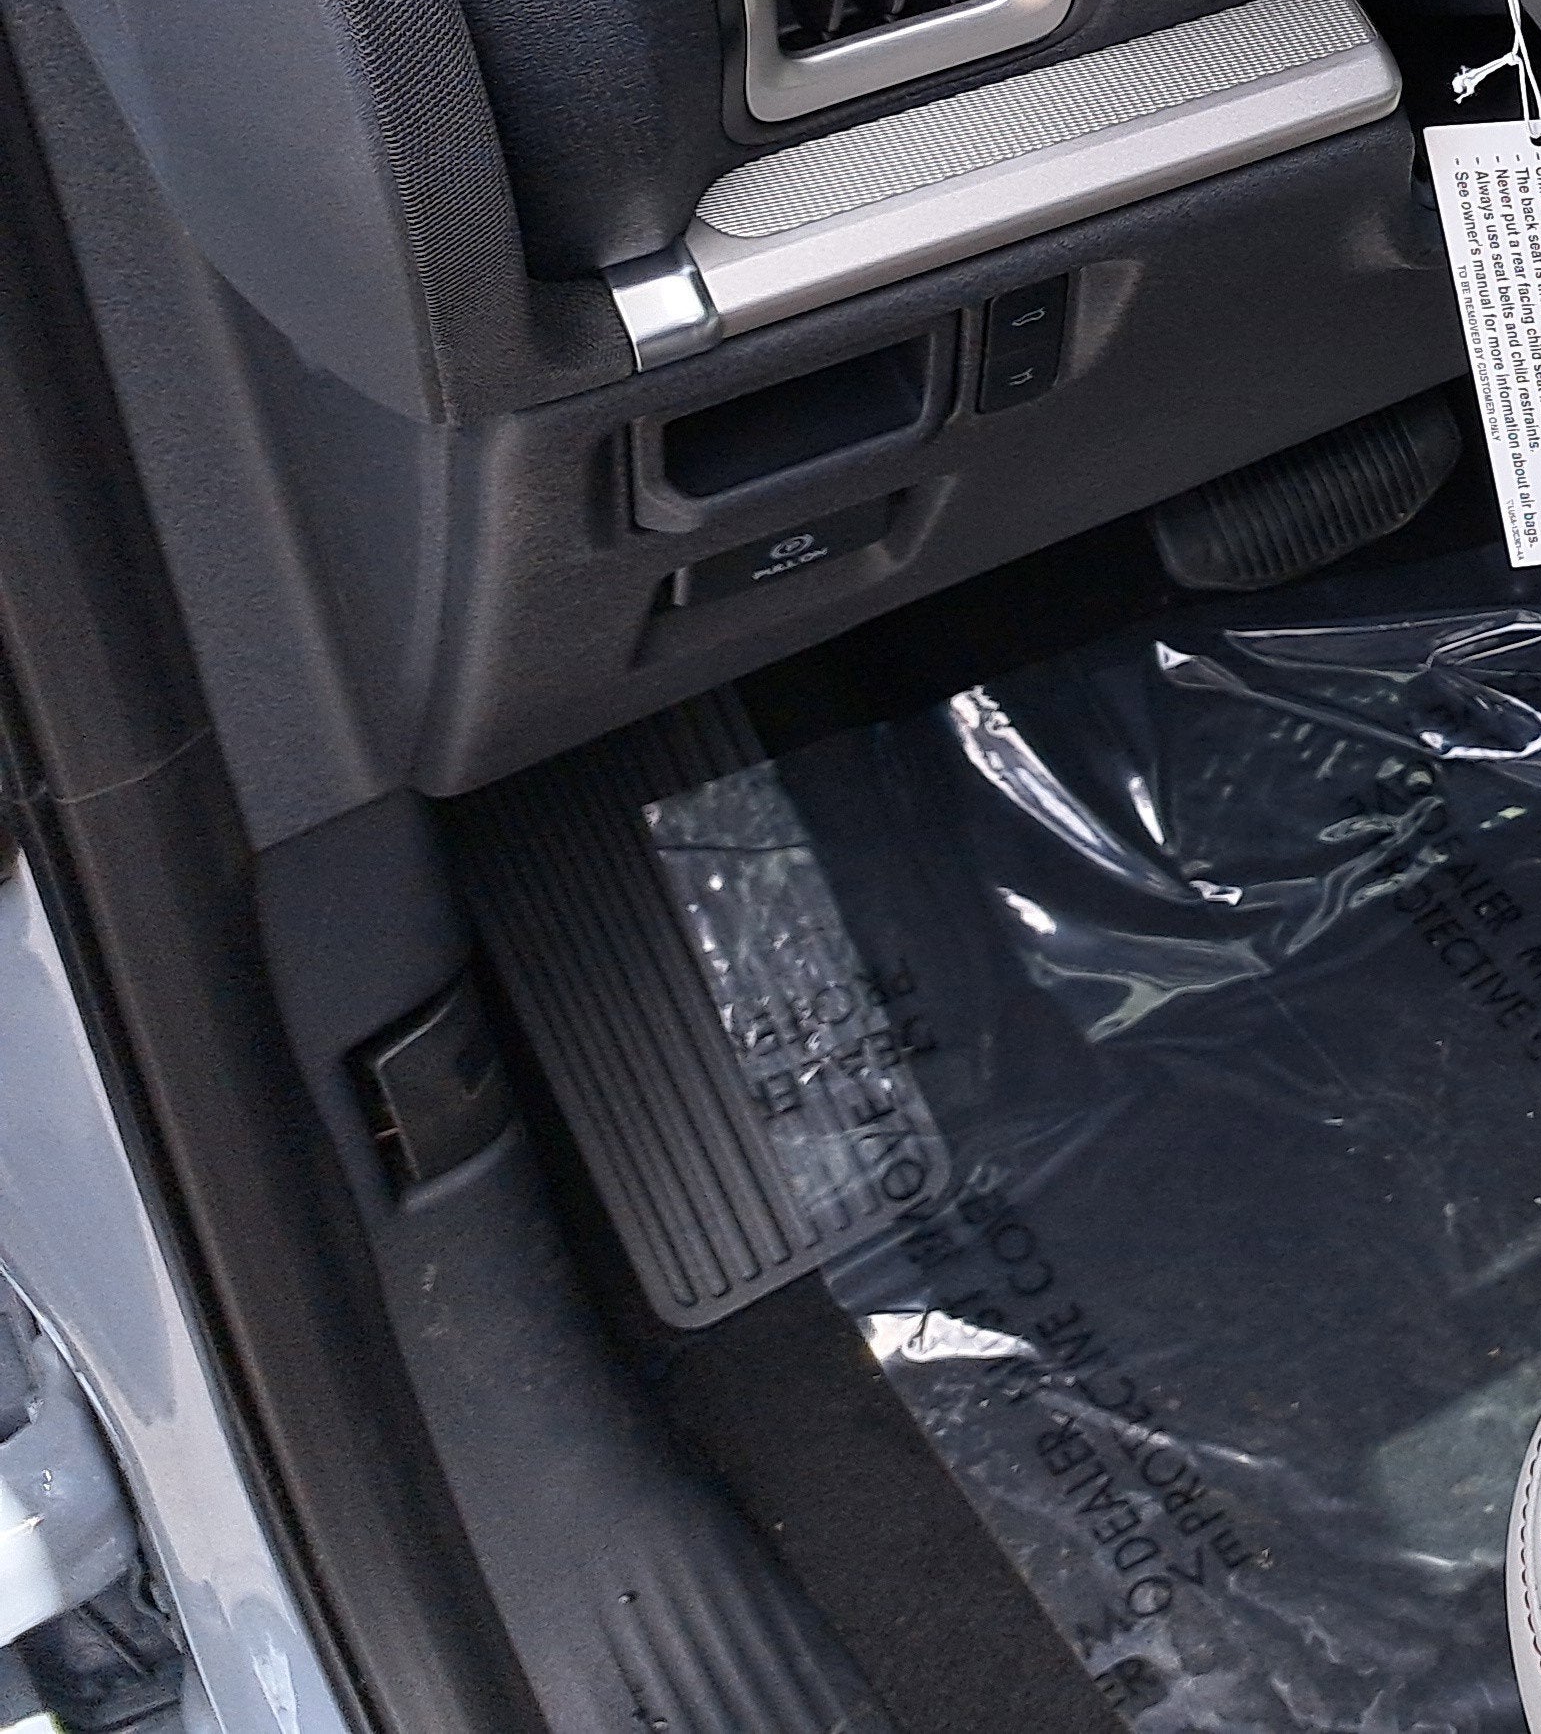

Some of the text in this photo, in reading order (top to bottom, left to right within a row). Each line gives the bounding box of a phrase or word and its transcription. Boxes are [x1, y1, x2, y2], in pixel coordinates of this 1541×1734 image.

[1454, 171, 1470, 198] See
[1494, 168, 1513, 210] Never
[1515, 166, 1531, 194] The
[1460, 201, 1483, 256] owner's
[1499, 213, 1521, 237] put
[1520, 197, 1540, 231] back
[1508, 239, 1520, 248] a
[1510, 251, 1527, 279] rear
[1472, 259, 1496, 310] manual
[1474, 170, 1541, 453] Always use seat belts and child restraints.
[1517, 282, 1536, 325] facing
[1482, 313, 1498, 333] for
[1487, 336, 1505, 371] more
[1495, 373, 1521, 449] information
[1511, 452, 1531, 490] about
[1519, 492, 1535, 509] air
[1523, 511, 1539, 548] bags.
[1031, 1415, 1162, 1576] DEALER
